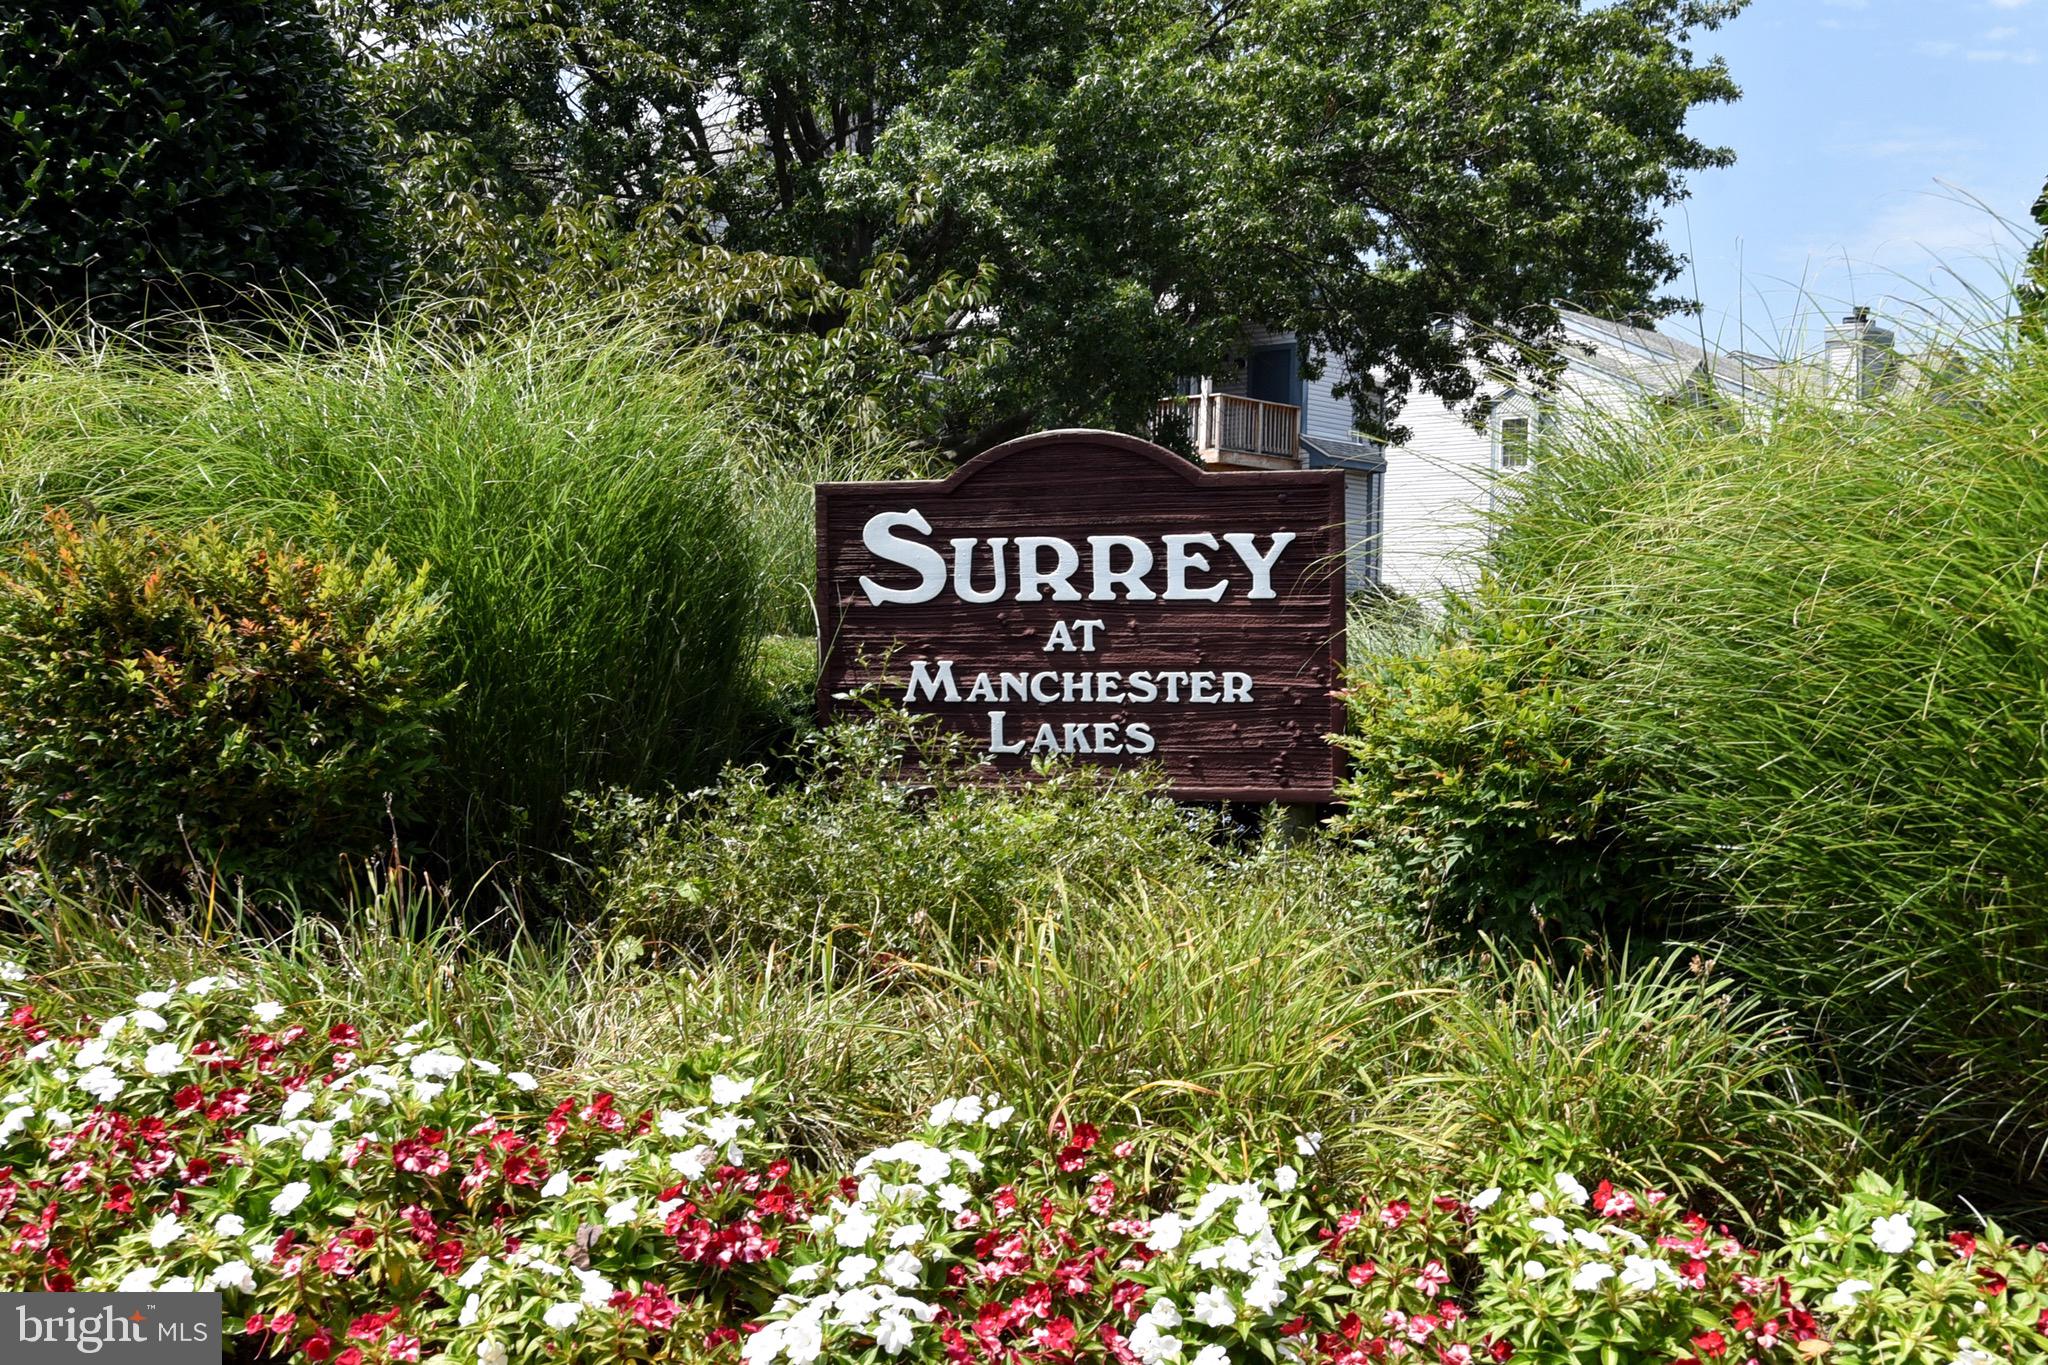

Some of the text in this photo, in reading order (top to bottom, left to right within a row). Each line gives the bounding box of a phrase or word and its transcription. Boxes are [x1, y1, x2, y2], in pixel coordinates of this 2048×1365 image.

[858, 508, 1297, 607] SURREY
[1042, 618, 1106, 652] AT
[902, 659, 1254, 704] MANCHESTER
[987, 710, 1156, 755] LAKES
